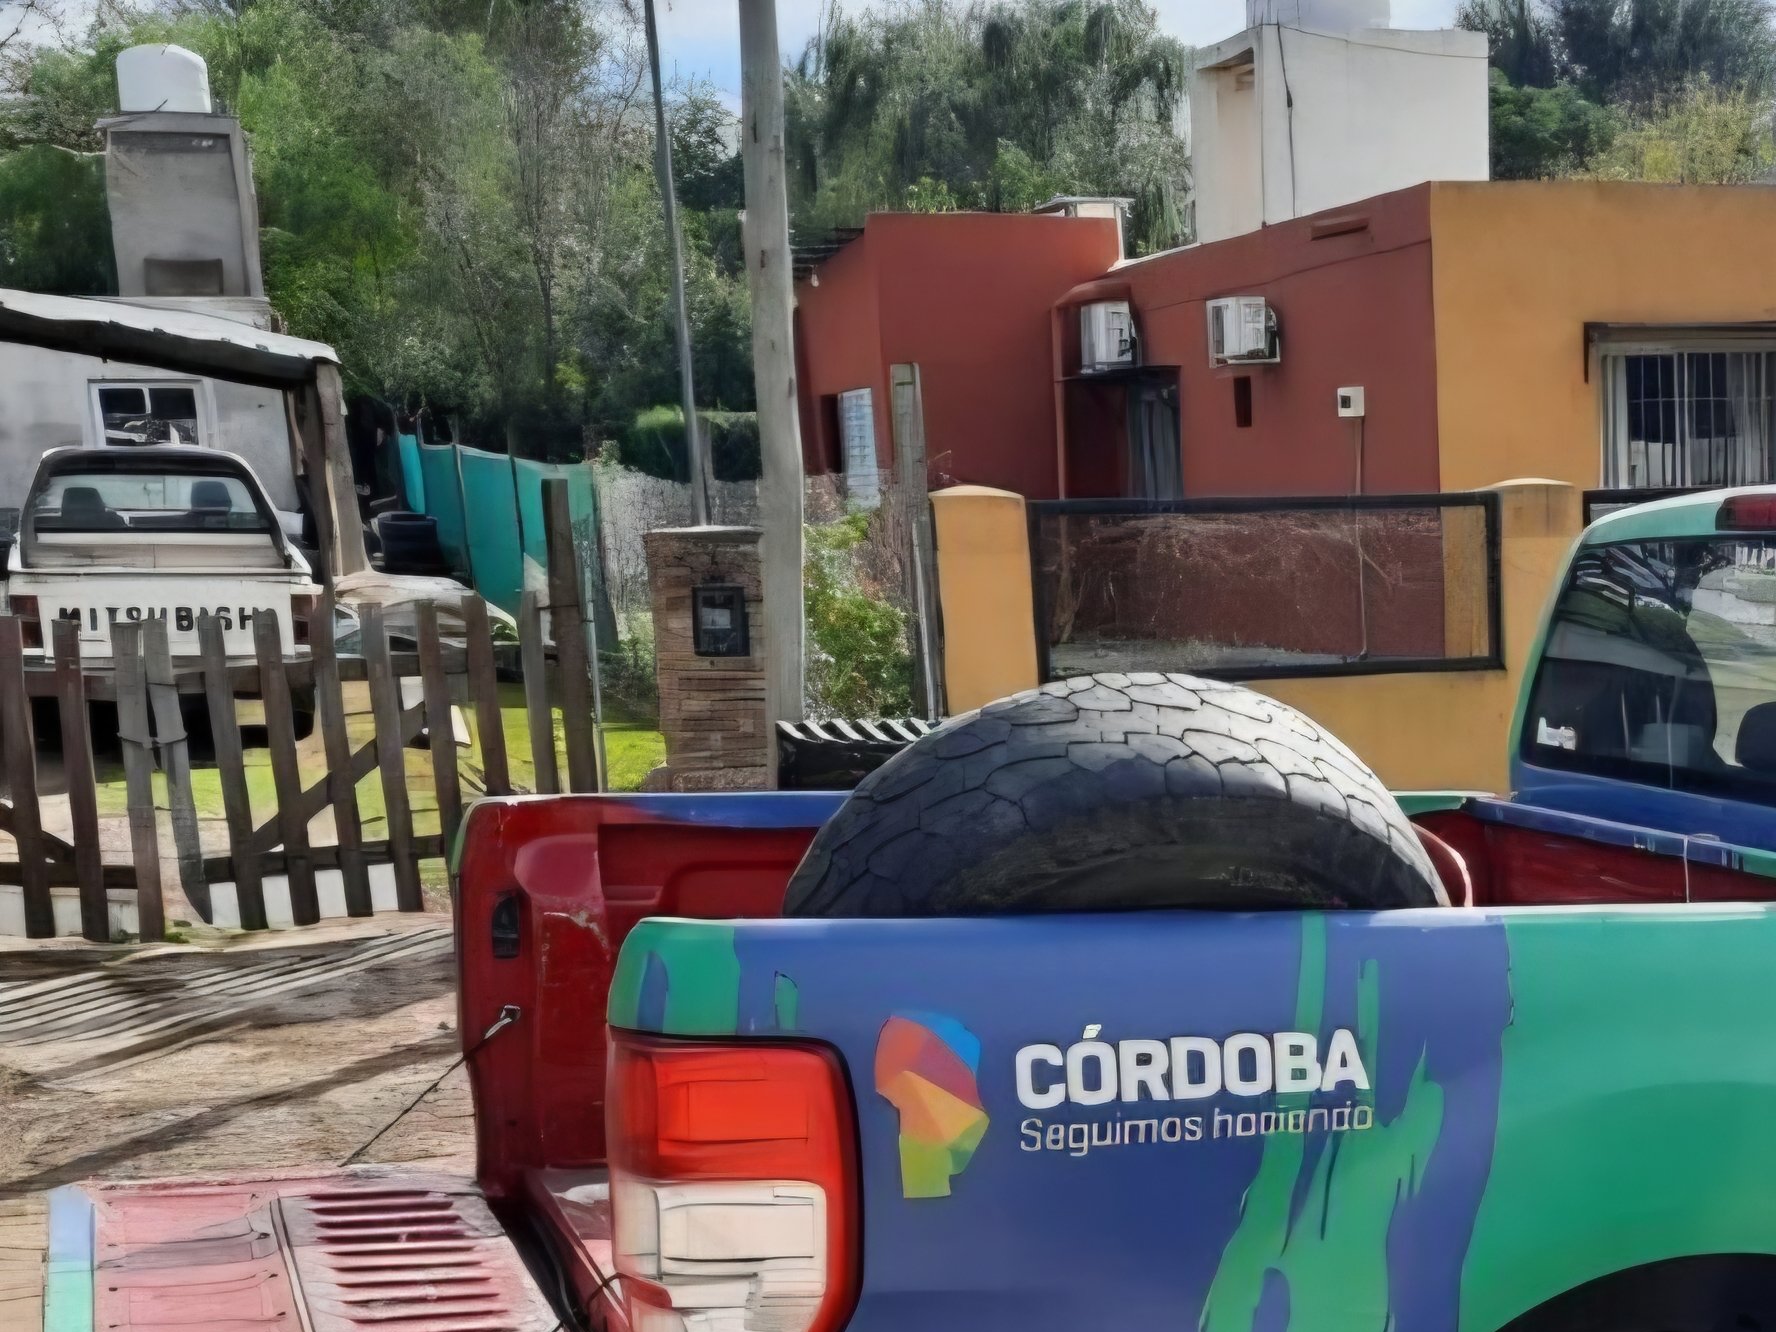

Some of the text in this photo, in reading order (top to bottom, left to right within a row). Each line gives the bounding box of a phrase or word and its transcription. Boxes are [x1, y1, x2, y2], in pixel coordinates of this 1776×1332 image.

[58, 606, 256, 631] MITSUBSH
[1015, 1024, 1370, 1110] CÓRDOBA
[1019, 1111, 1203, 1158] Seguimos
